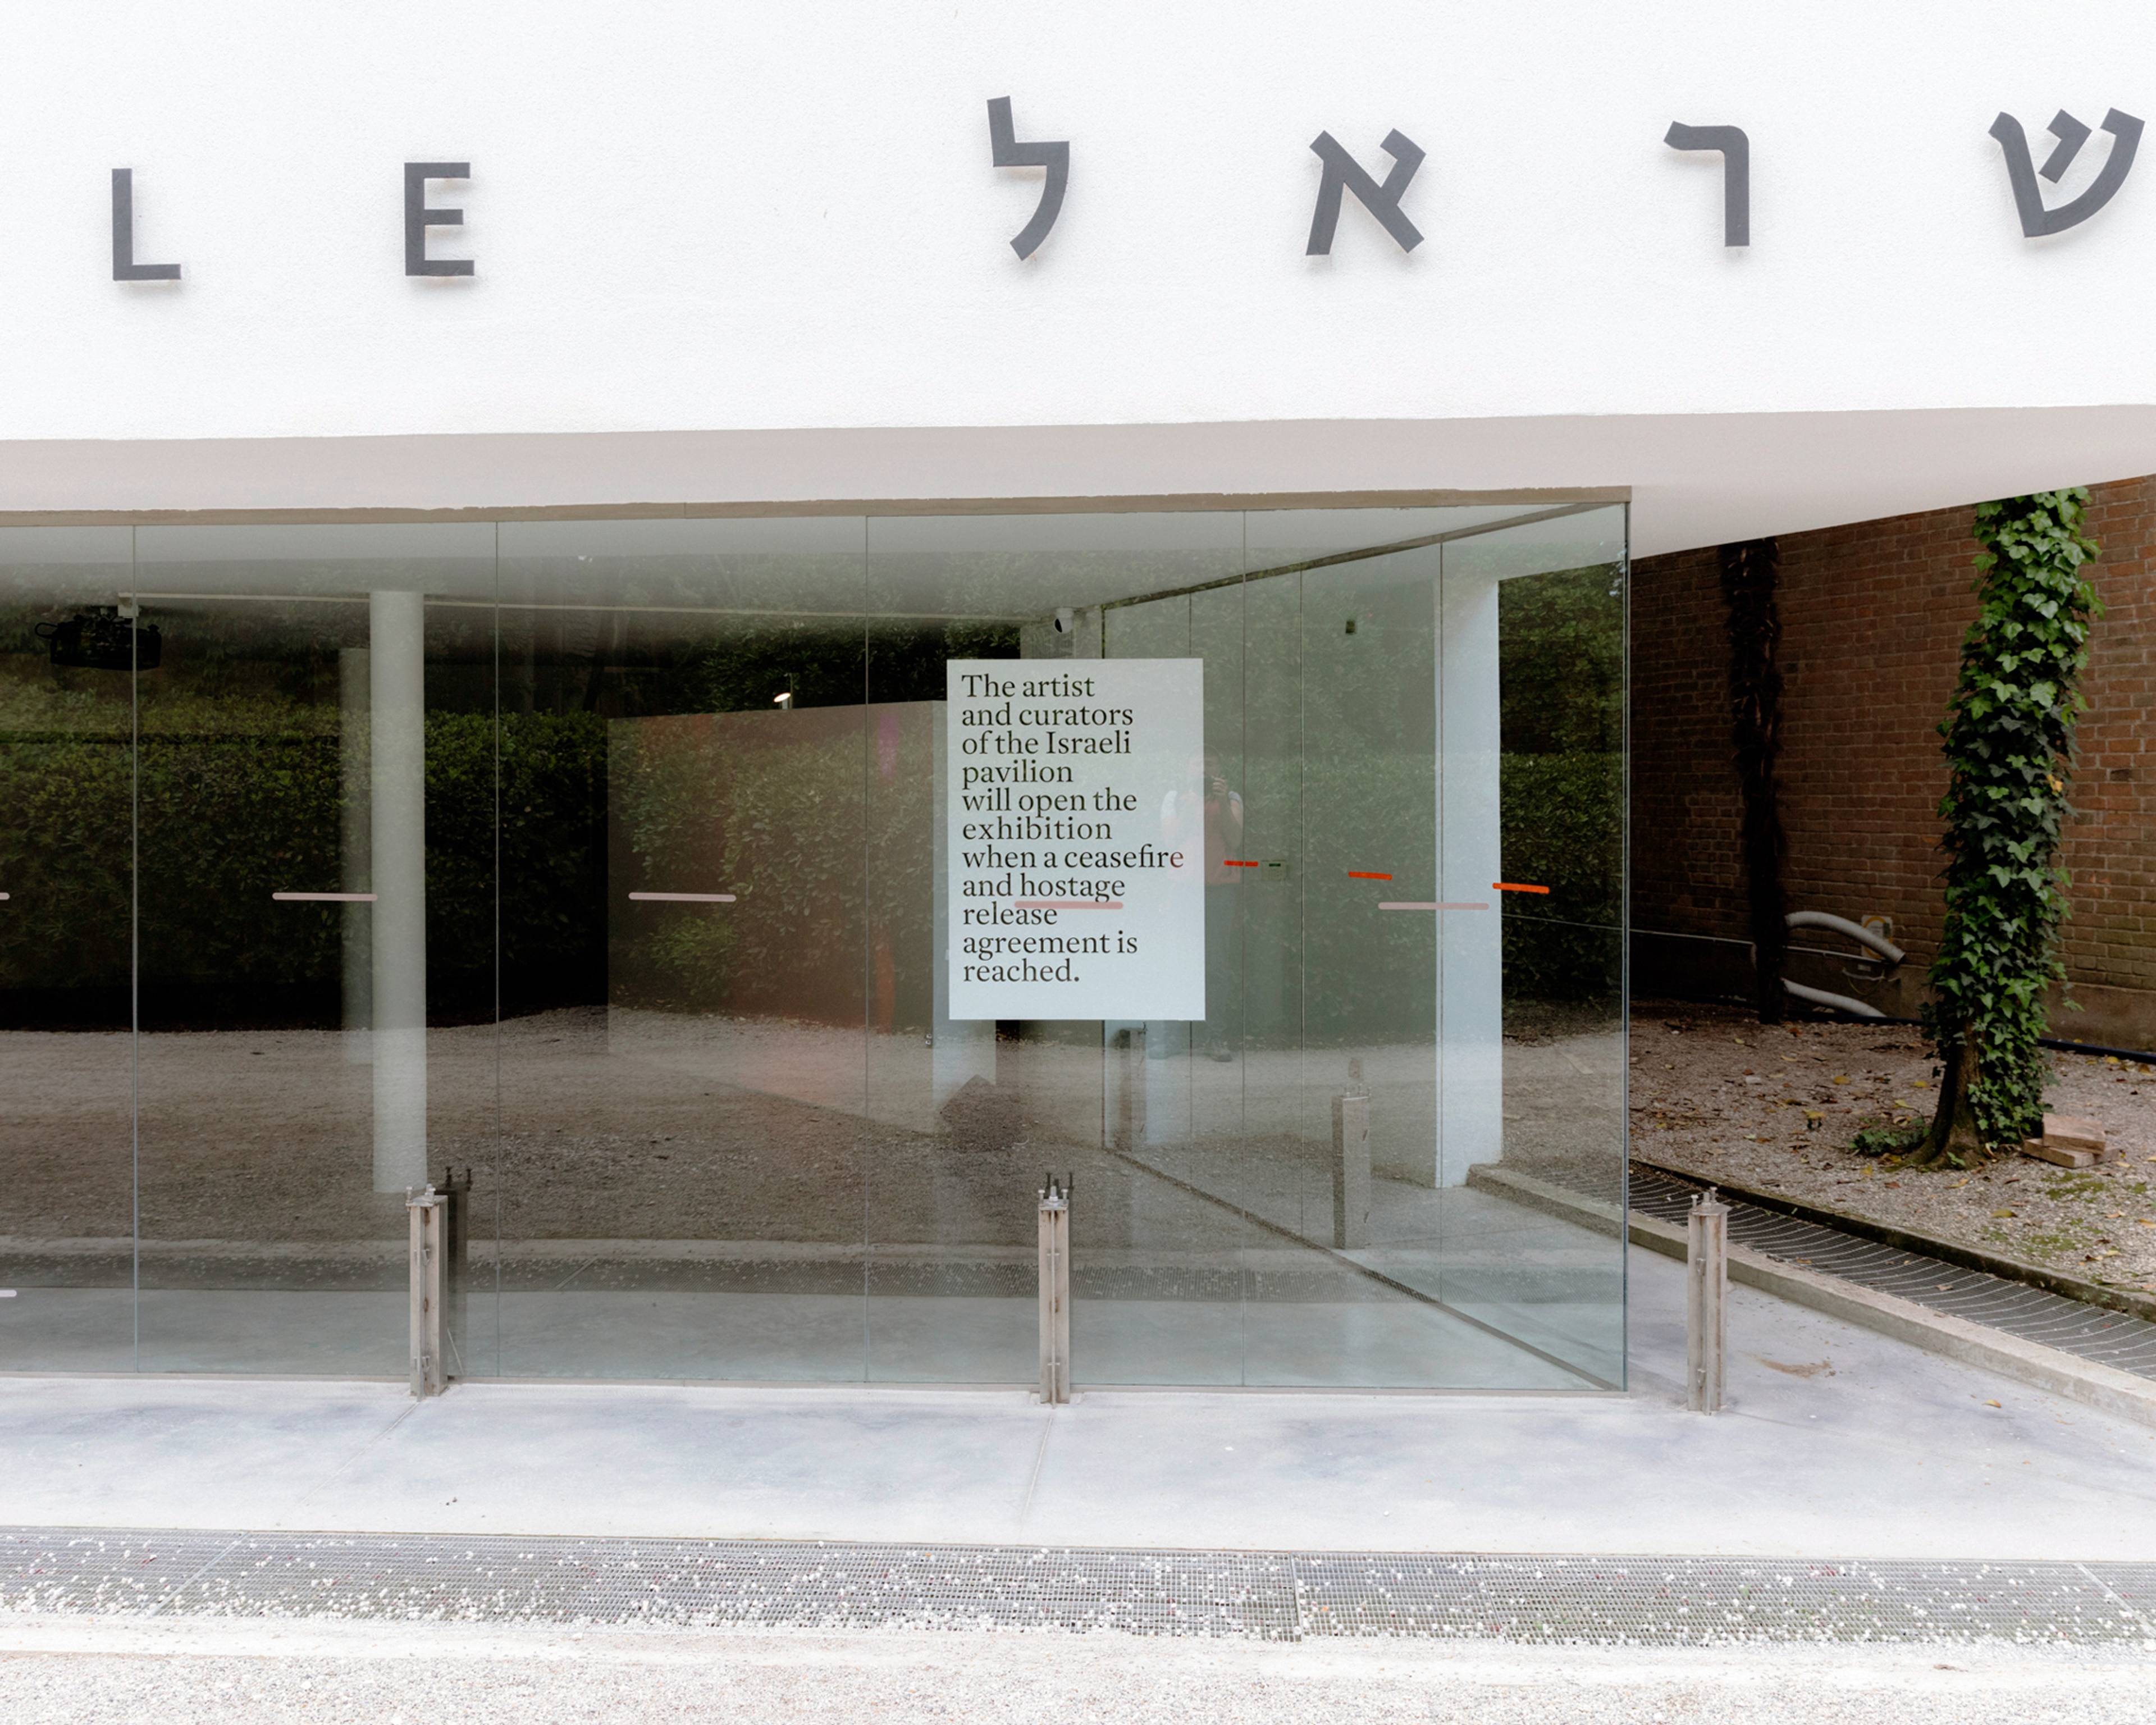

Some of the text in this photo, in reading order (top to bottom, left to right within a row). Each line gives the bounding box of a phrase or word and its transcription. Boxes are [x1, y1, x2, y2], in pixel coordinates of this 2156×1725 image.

[961, 672, 1096, 698] The artist
[961, 701, 1134, 727] and curators
[961, 729, 1132, 755] of the Israeli
[961, 758, 1074, 791] pavilion
[961, 786, 1138, 819] will open the
[962, 815, 1113, 841] exhibition
[961, 843, 1184, 869] when a ceasefire
[962, 871, 1126, 903] and hostage
[963, 900, 1058, 925] release
[963, 929, 1138, 961] agreement is
[963, 957, 1080, 983] reached.
